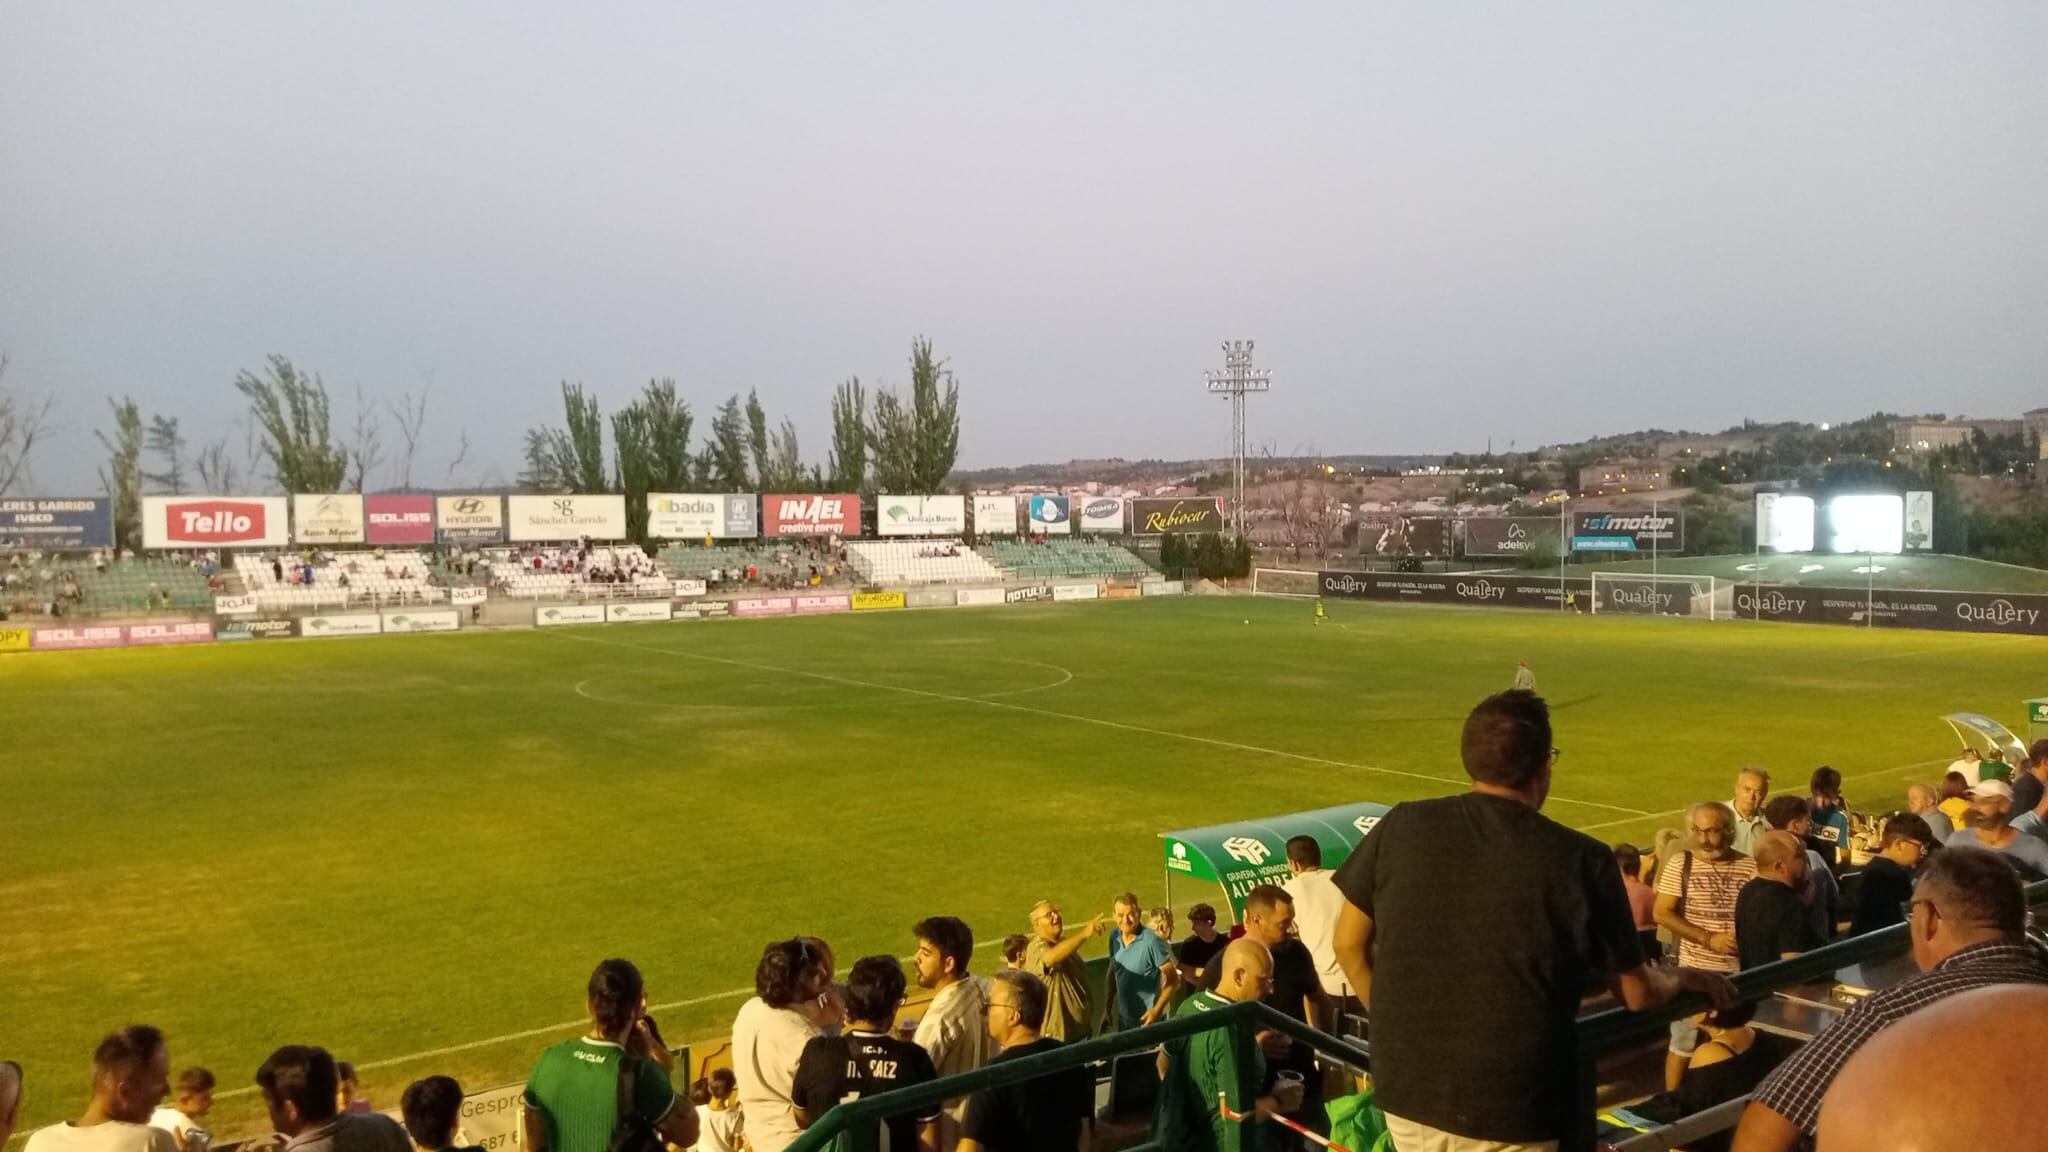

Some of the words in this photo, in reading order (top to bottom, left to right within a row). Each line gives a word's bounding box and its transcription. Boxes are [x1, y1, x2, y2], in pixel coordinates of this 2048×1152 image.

[39, 501, 95, 511] GARRIDO
[553, 499, 573, 516] sg
[779, 496, 844, 523] INAEL
[15, 514, 54, 523] IVECO
[181, 512, 251, 533] Tello
[370, 513, 431, 523] SOLISS
[1145, 500, 1210, 531] Rubiocar
[1325, 576, 1367, 592] Qualery
[1456, 581, 1505, 599] Qualery
[738, 598, 791, 610] SOLISS
[1613, 587, 1672, 606] Qualery
[1738, 592, 1806, 613] Qualery
[1957, 600, 2040, 624] Qualery
[37, 627, 120, 642] SOLISS
[130, 623, 210, 638] SOLISS
[1226, 869, 1257, 882] GRAVERA
